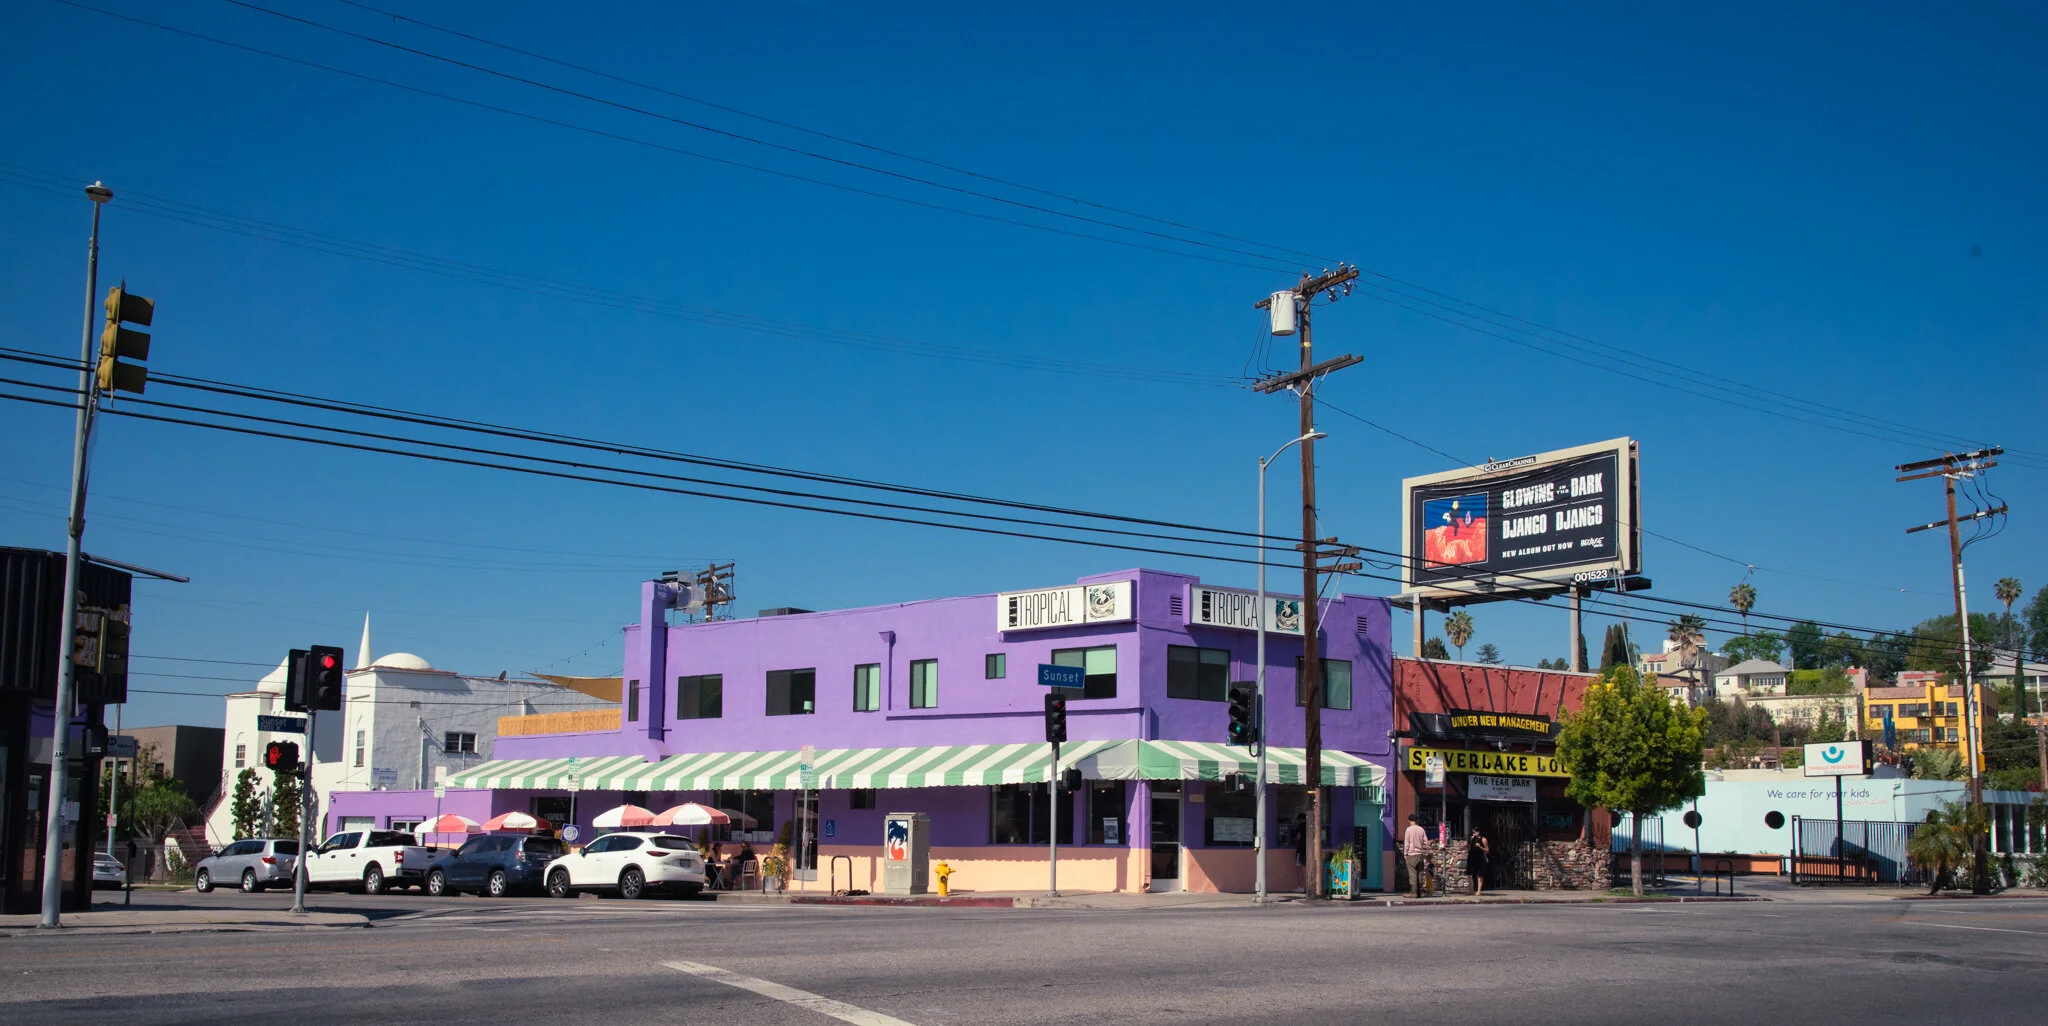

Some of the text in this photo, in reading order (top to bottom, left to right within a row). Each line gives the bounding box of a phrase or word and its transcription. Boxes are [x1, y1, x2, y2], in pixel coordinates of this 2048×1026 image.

[1502, 483, 1554, 509] GLOWING
[1571, 473, 1603, 497] DARK
[1502, 504, 1603, 539] DJANGO DJANGO
[1502, 541, 1573, 558] NEW ALBUM OUT NOW
[1574, 569, 1608, 583] 001523
[1018, 590, 1073, 627] TROPICAL
[1211, 591, 1259, 628] TROPICA
[1043, 669, 1080, 683] Sunset
[260, 716, 287, 727] Sunset
[1451, 715, 1550, 734] UNDER NEW MANAGEMENT
[1412, 750, 1528, 772] SVERLAKE
[1473, 776, 1531, 788] ONE YEAR DARK
[1767, 788, 1870, 801] We care for yor kids
